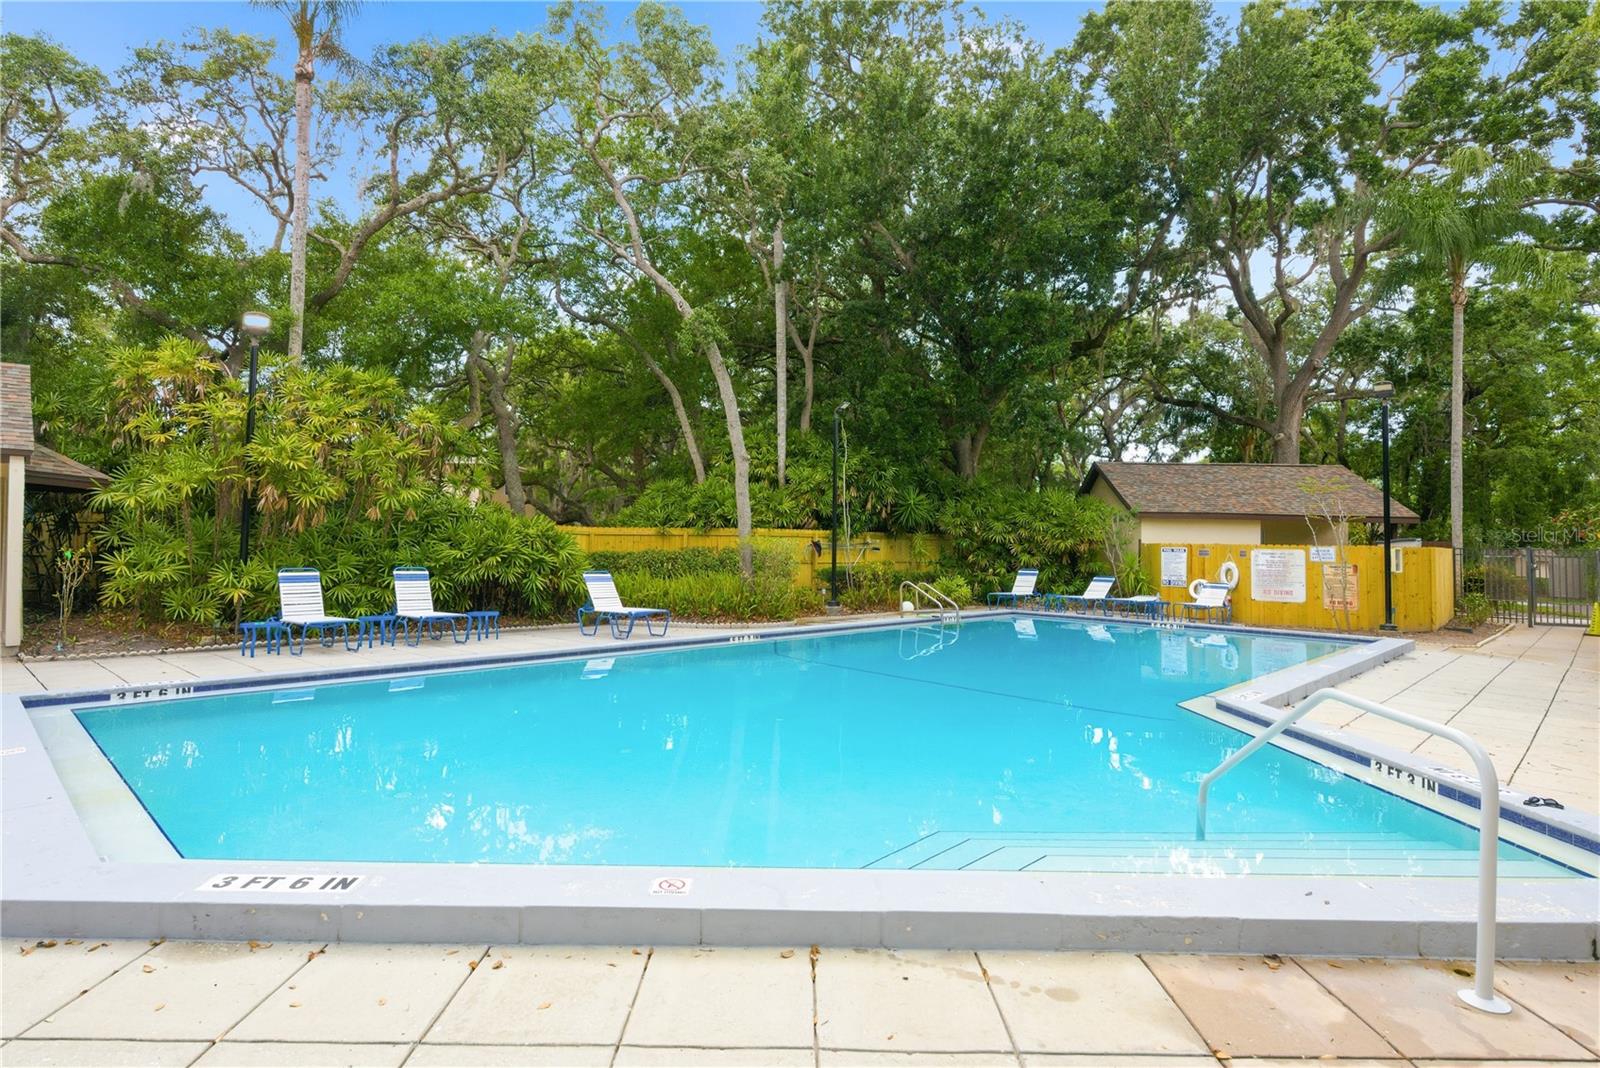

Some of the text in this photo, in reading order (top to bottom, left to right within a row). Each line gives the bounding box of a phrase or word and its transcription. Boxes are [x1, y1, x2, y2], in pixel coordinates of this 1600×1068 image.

[133, 690, 153, 698] FT
[1375, 761, 1436, 792] 3 FT 3 IN
[211, 876, 359, 890] 3 FT 6 IN
